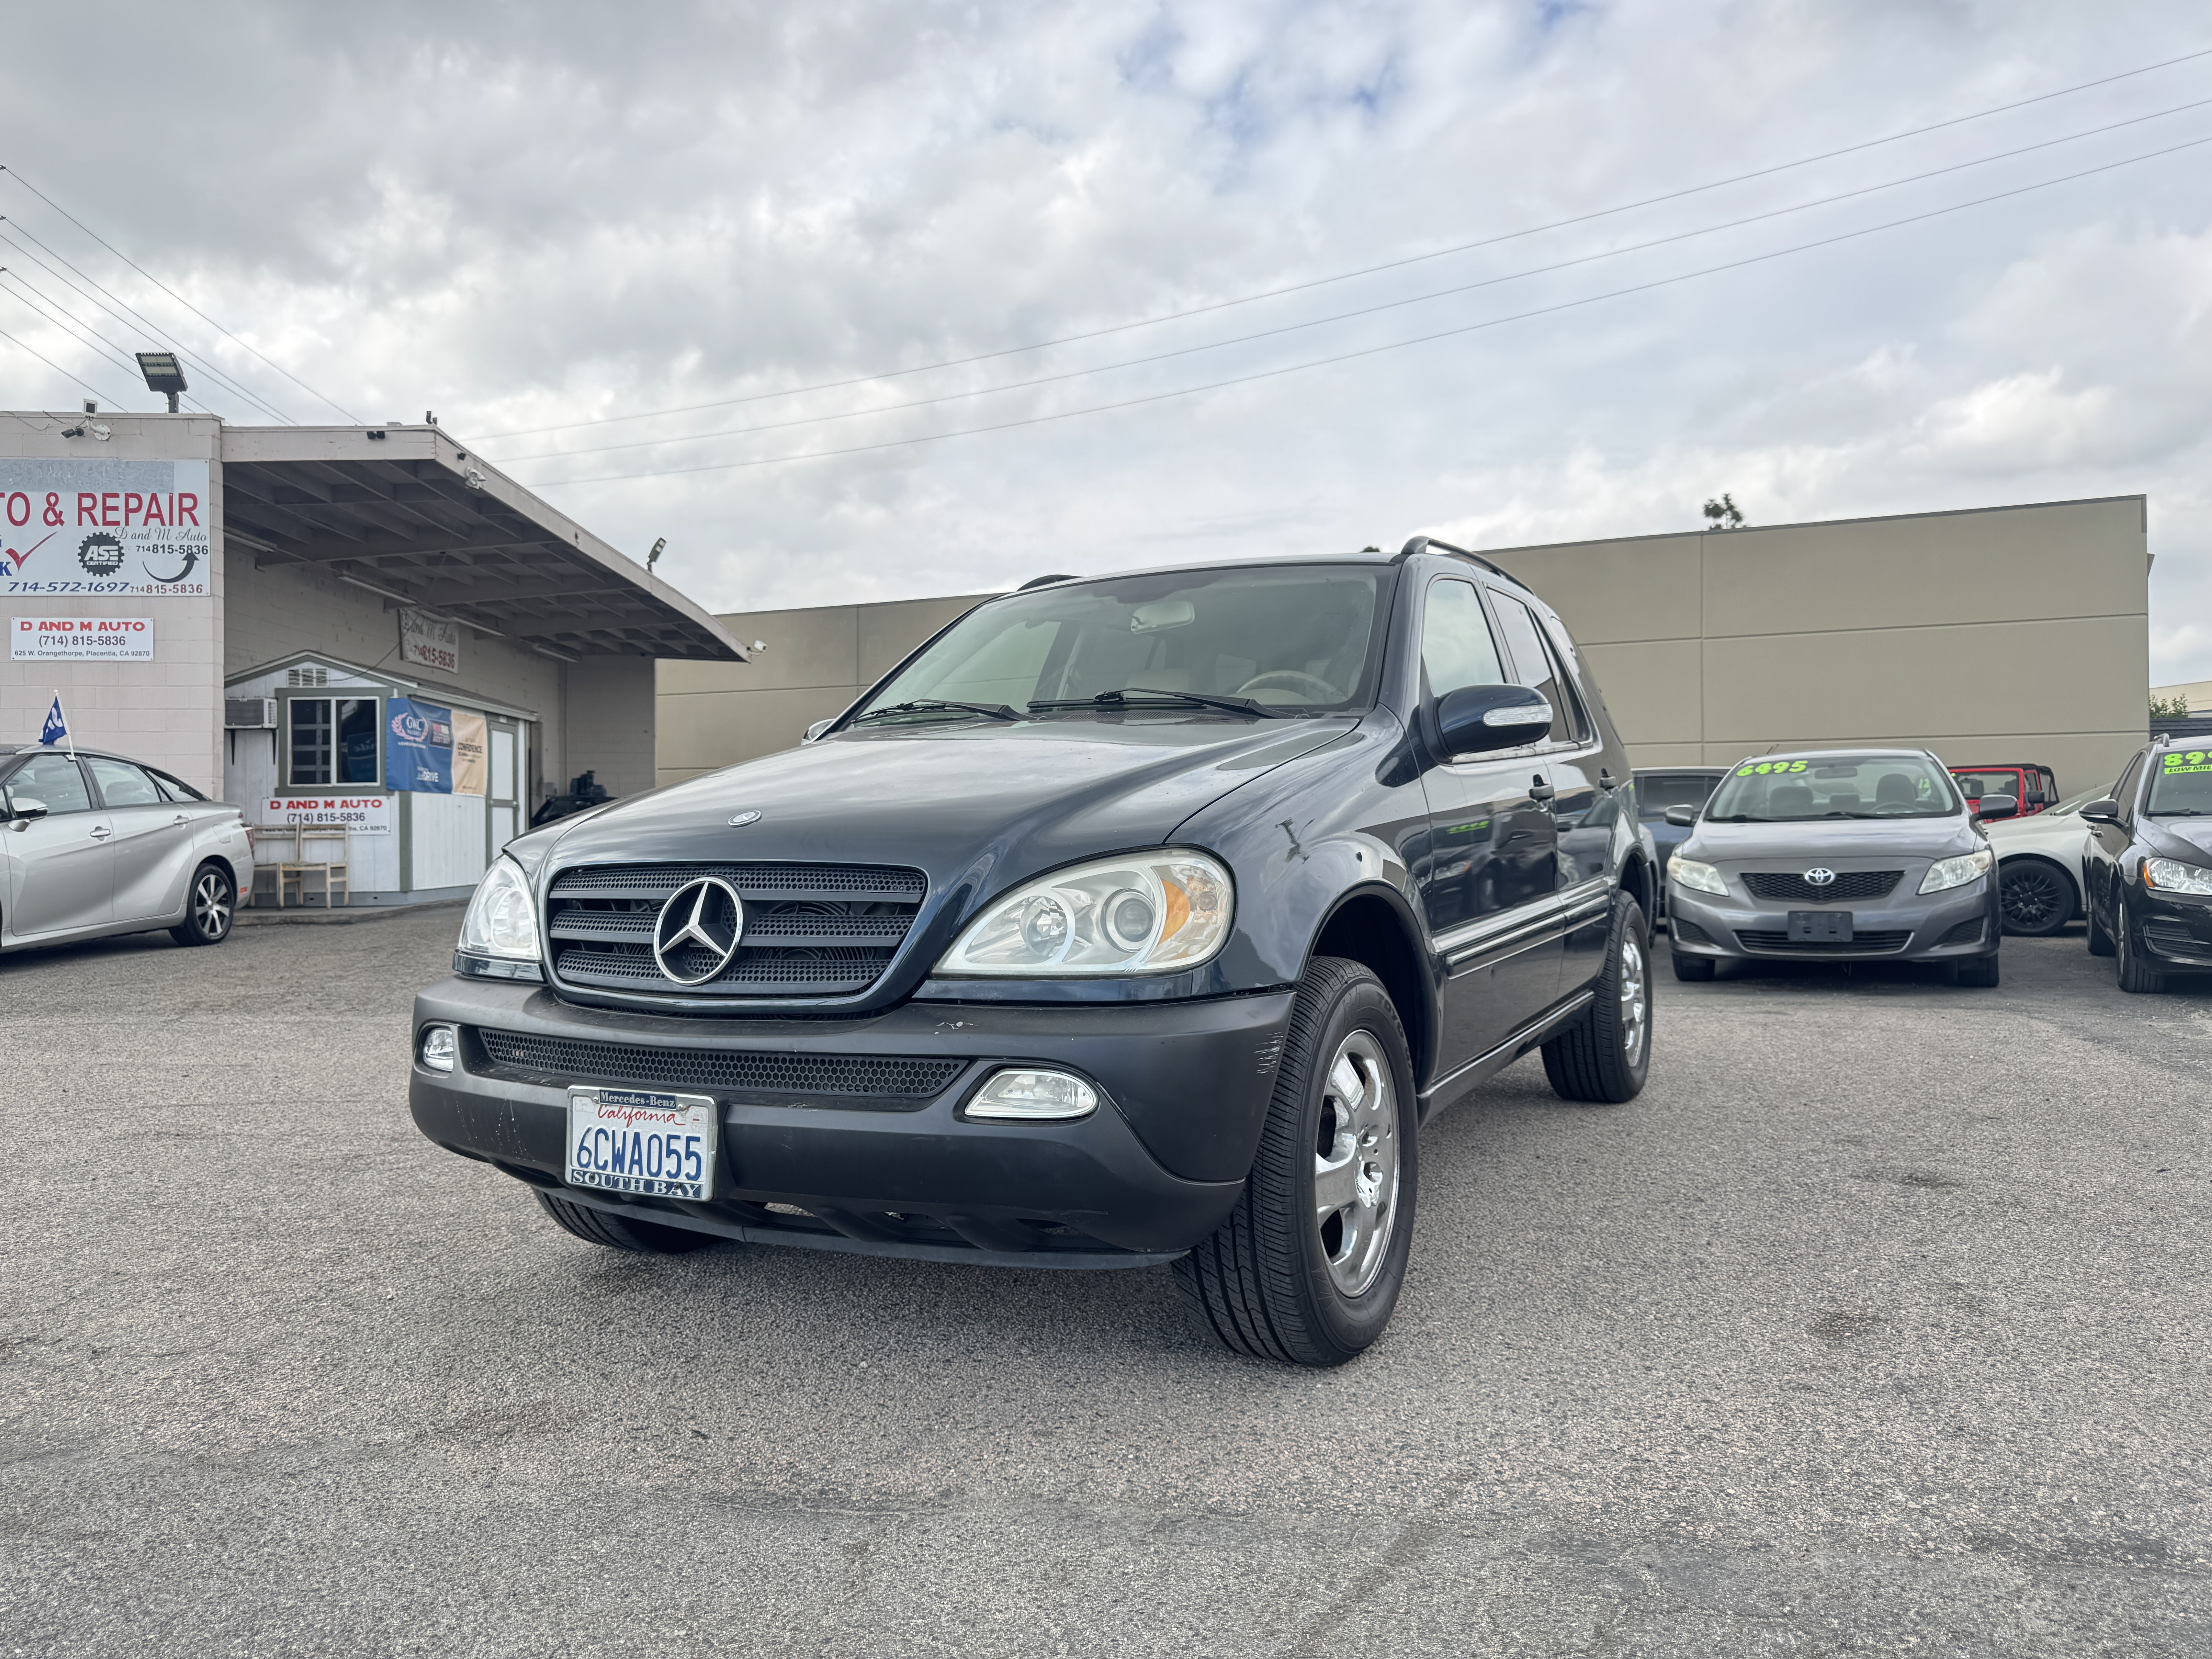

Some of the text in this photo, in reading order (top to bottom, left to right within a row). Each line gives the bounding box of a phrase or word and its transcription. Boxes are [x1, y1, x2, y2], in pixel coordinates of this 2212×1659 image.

[0, 492, 199, 527] O & REPAIR
[115, 526, 208, 541] D and M Auto
[84, 546, 118, 561] ASE
[8, 582, 129, 592] 714-572-1697
[20, 622, 145, 632] D AND M AUTO
[39, 635, 126, 648] (714) 815-5836
[2164, 751, 2212, 766] 89
[270, 799, 382, 809] D AND M AUTO
[287, 812, 365, 824] (714) 815-5836
[601, 1092, 675, 1108] Mercedes-Benz
[598, 1104, 686, 1128] California
[577, 1127, 702, 1181] 6CWA055
[573, 1171, 699, 1198] SOUTH BAY
